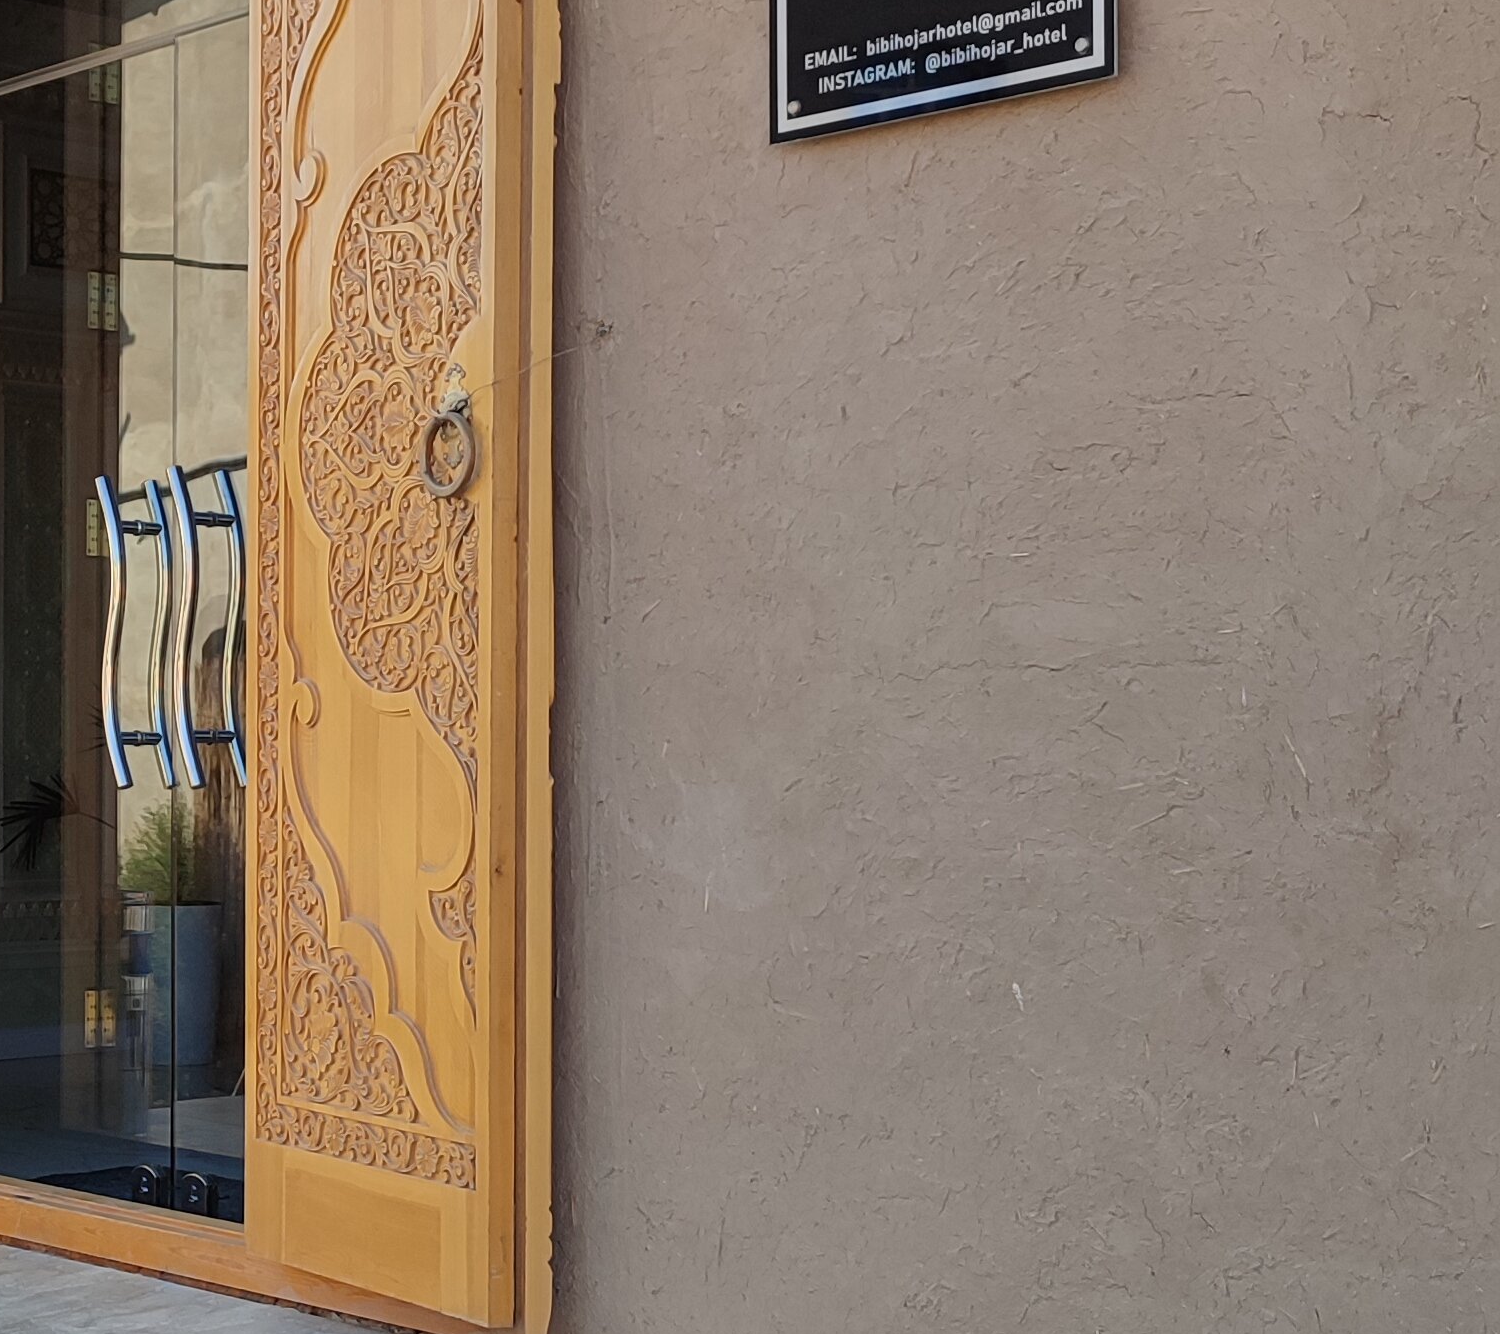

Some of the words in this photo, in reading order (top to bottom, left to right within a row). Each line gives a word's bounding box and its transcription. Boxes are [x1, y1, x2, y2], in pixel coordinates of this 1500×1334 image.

[804, 45, 857, 70] EMAIL:
[818, 58, 916, 95] INSTAGRAM:
[925, 24, 1067, 74] @bibihojar_hotel
